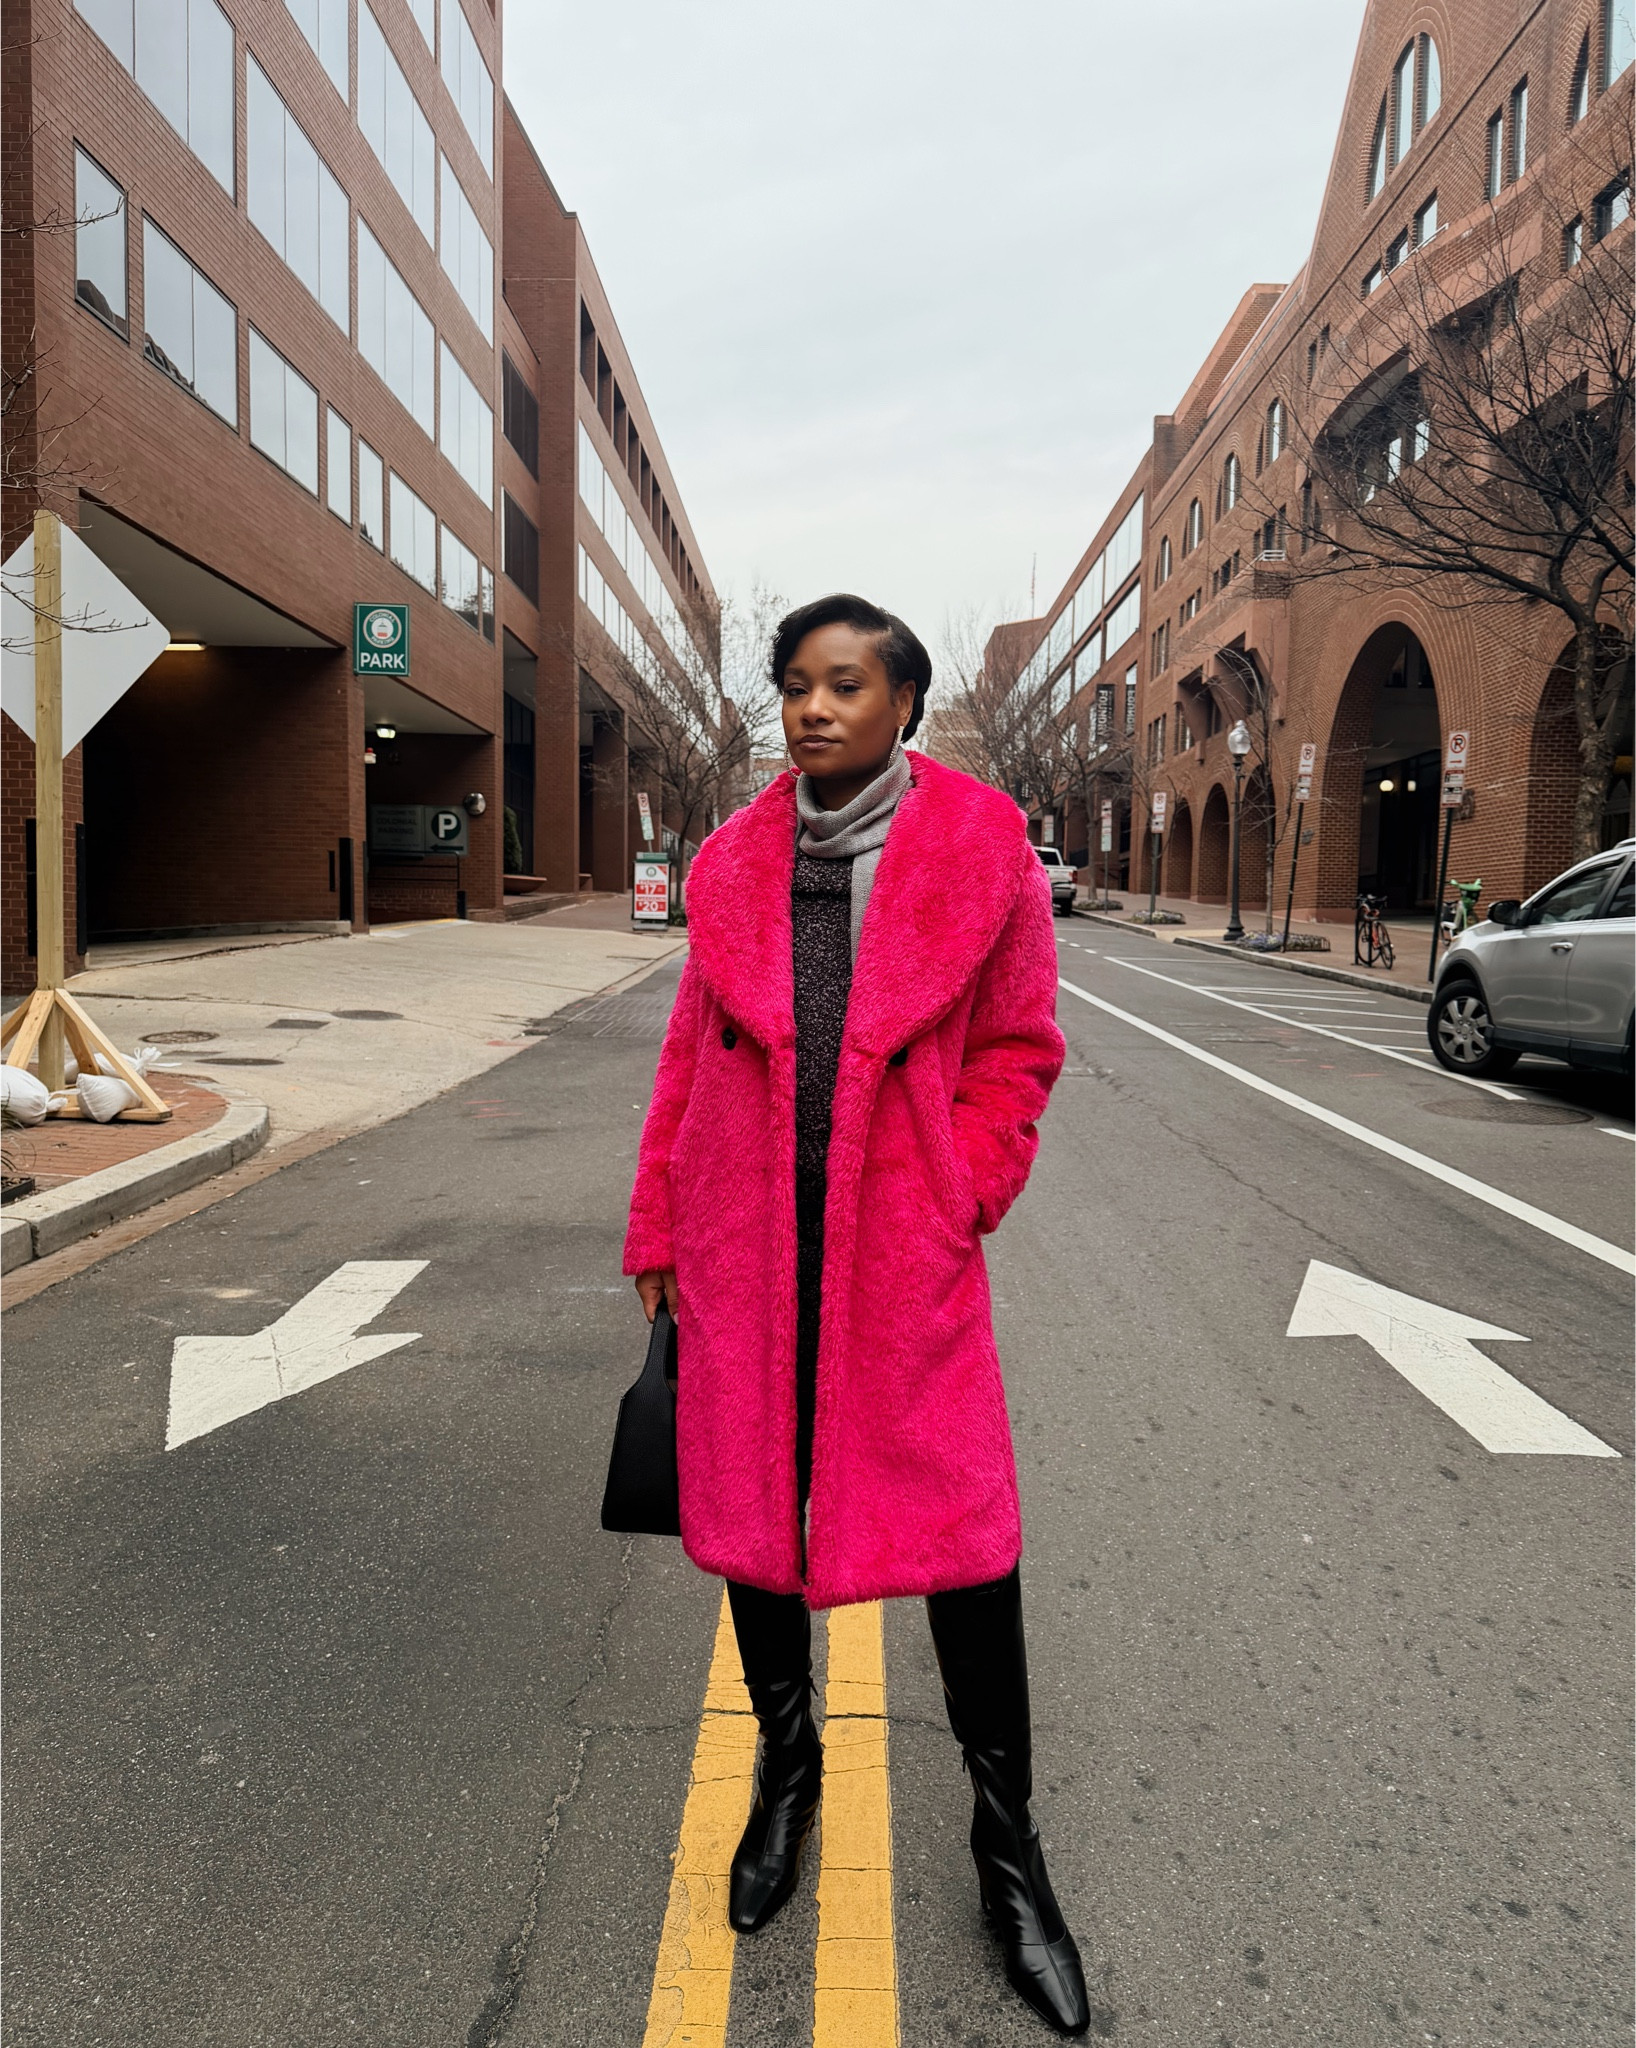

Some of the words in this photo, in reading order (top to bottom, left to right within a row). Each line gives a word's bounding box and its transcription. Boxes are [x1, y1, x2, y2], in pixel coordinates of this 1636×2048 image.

[360, 652, 405, 669] PARK
[1097, 690, 1109, 736] FOUNDRY
[438, 813, 458, 838] P
